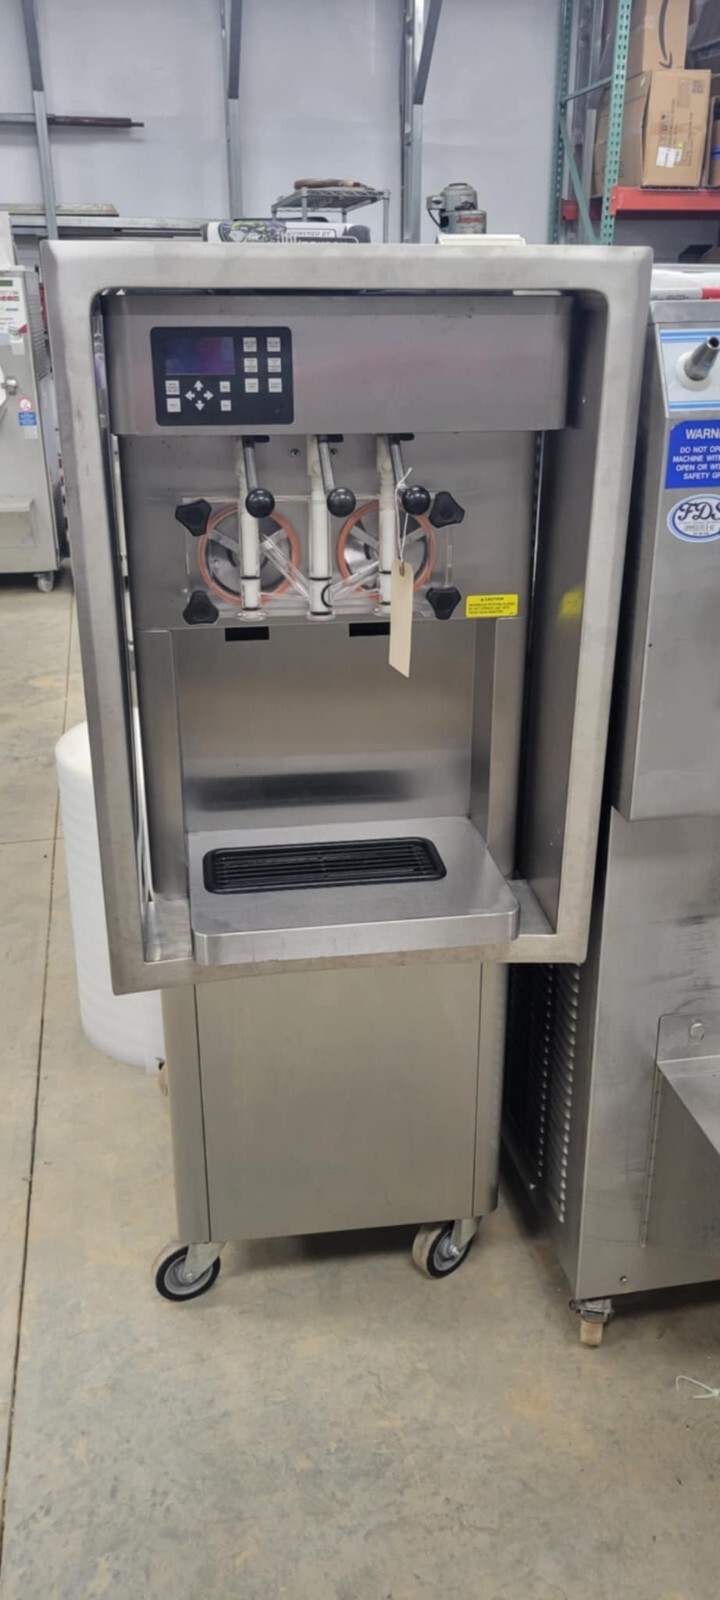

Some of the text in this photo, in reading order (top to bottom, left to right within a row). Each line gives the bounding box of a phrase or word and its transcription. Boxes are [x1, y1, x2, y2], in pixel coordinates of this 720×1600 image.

[679, 446, 691, 454] DO
[672, 455, 704, 463] MACHINE
[675, 464, 695, 472] OPEN
[696, 463, 708, 471] OR
[682, 472, 710, 480] SAFETY
